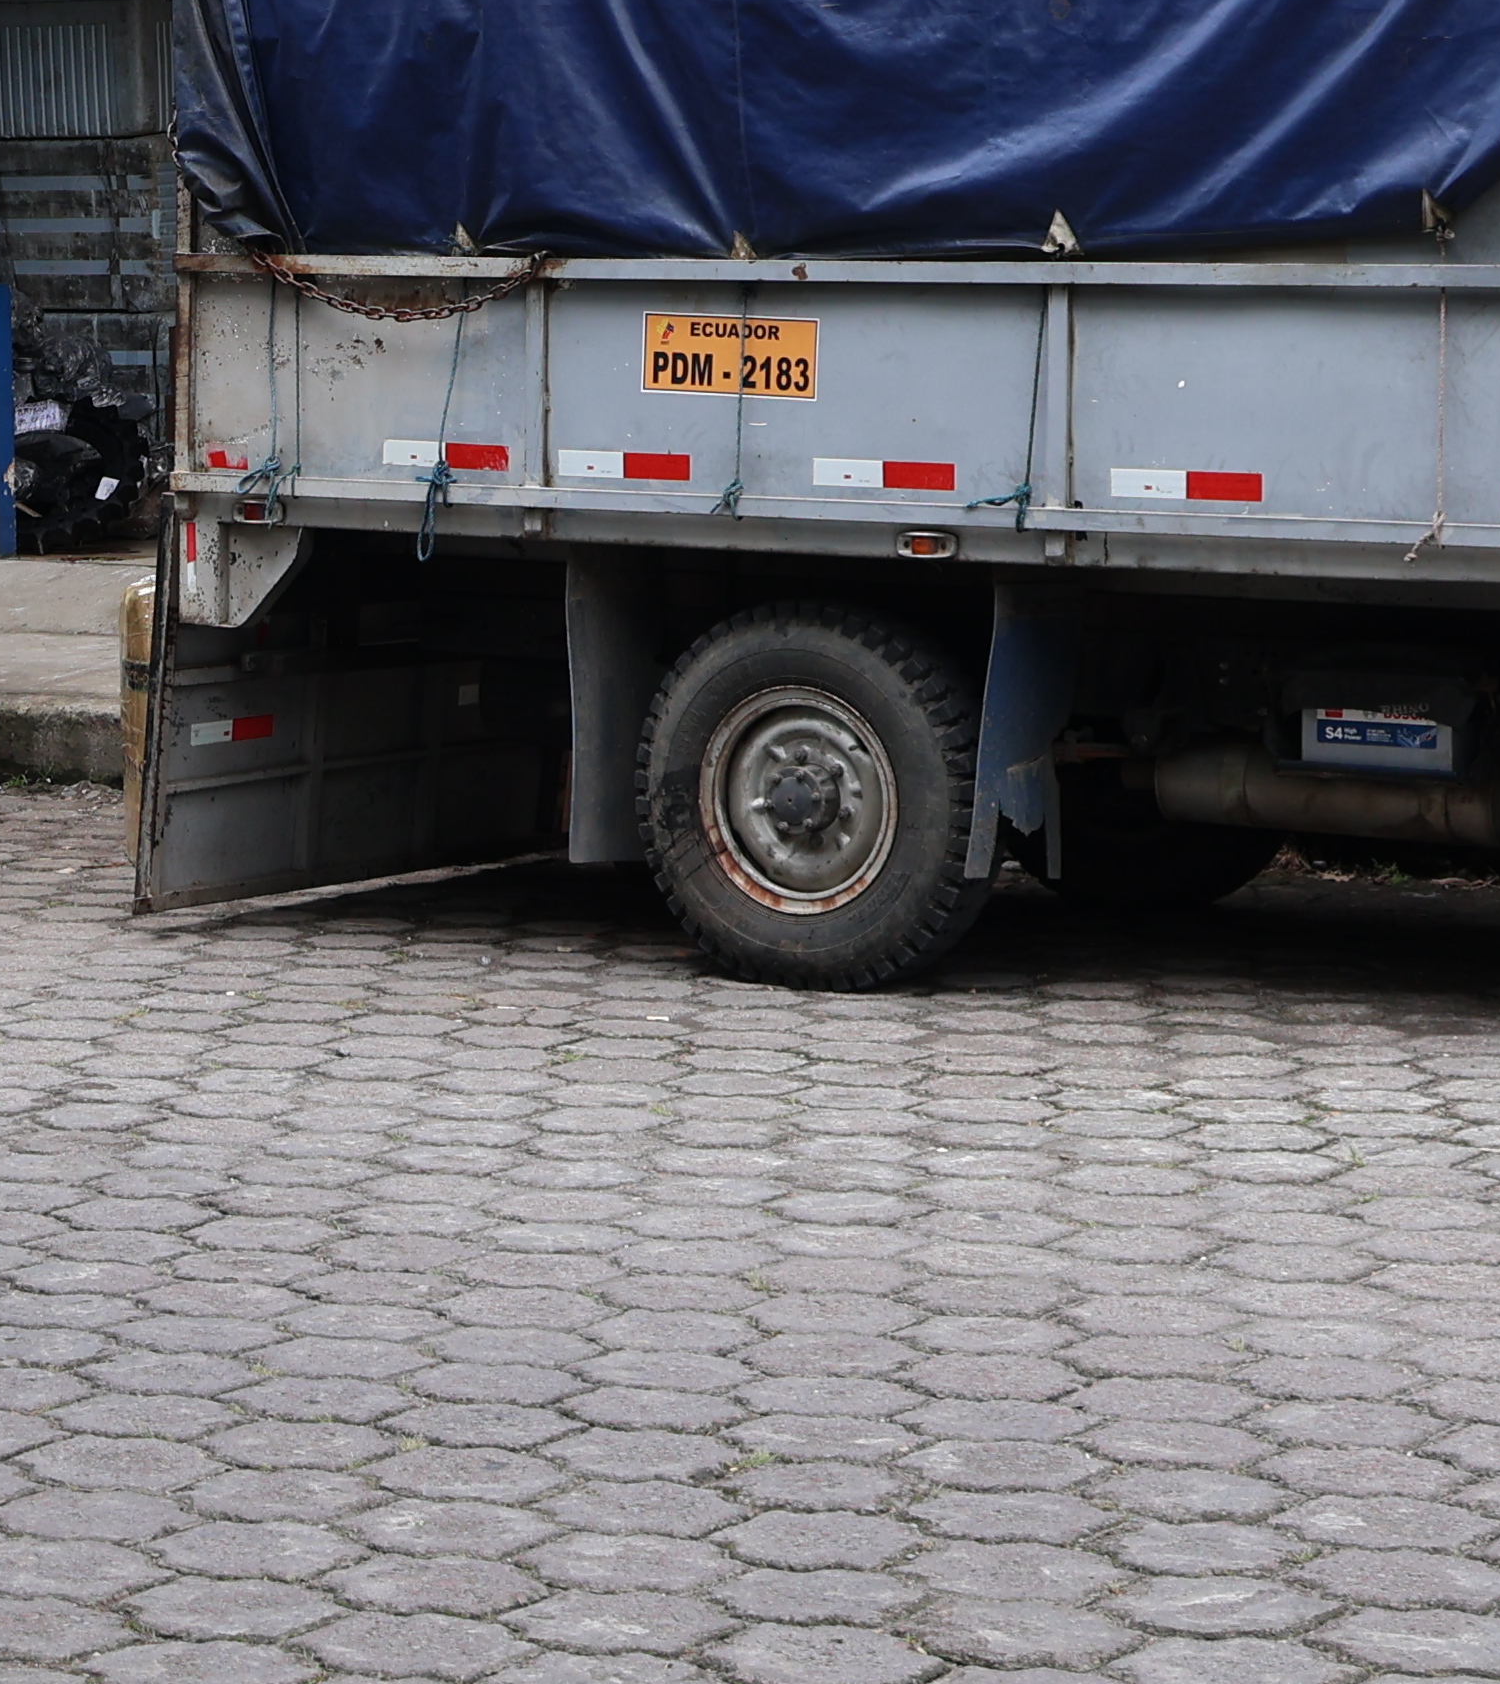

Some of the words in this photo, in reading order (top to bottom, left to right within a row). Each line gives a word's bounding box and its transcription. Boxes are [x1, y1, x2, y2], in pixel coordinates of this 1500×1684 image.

[690, 322, 780, 340] ECUADOR
[652, 351, 713, 386] PDM
[742, 355, 810, 392] 2183
[1325, 726, 1343, 740] S4
